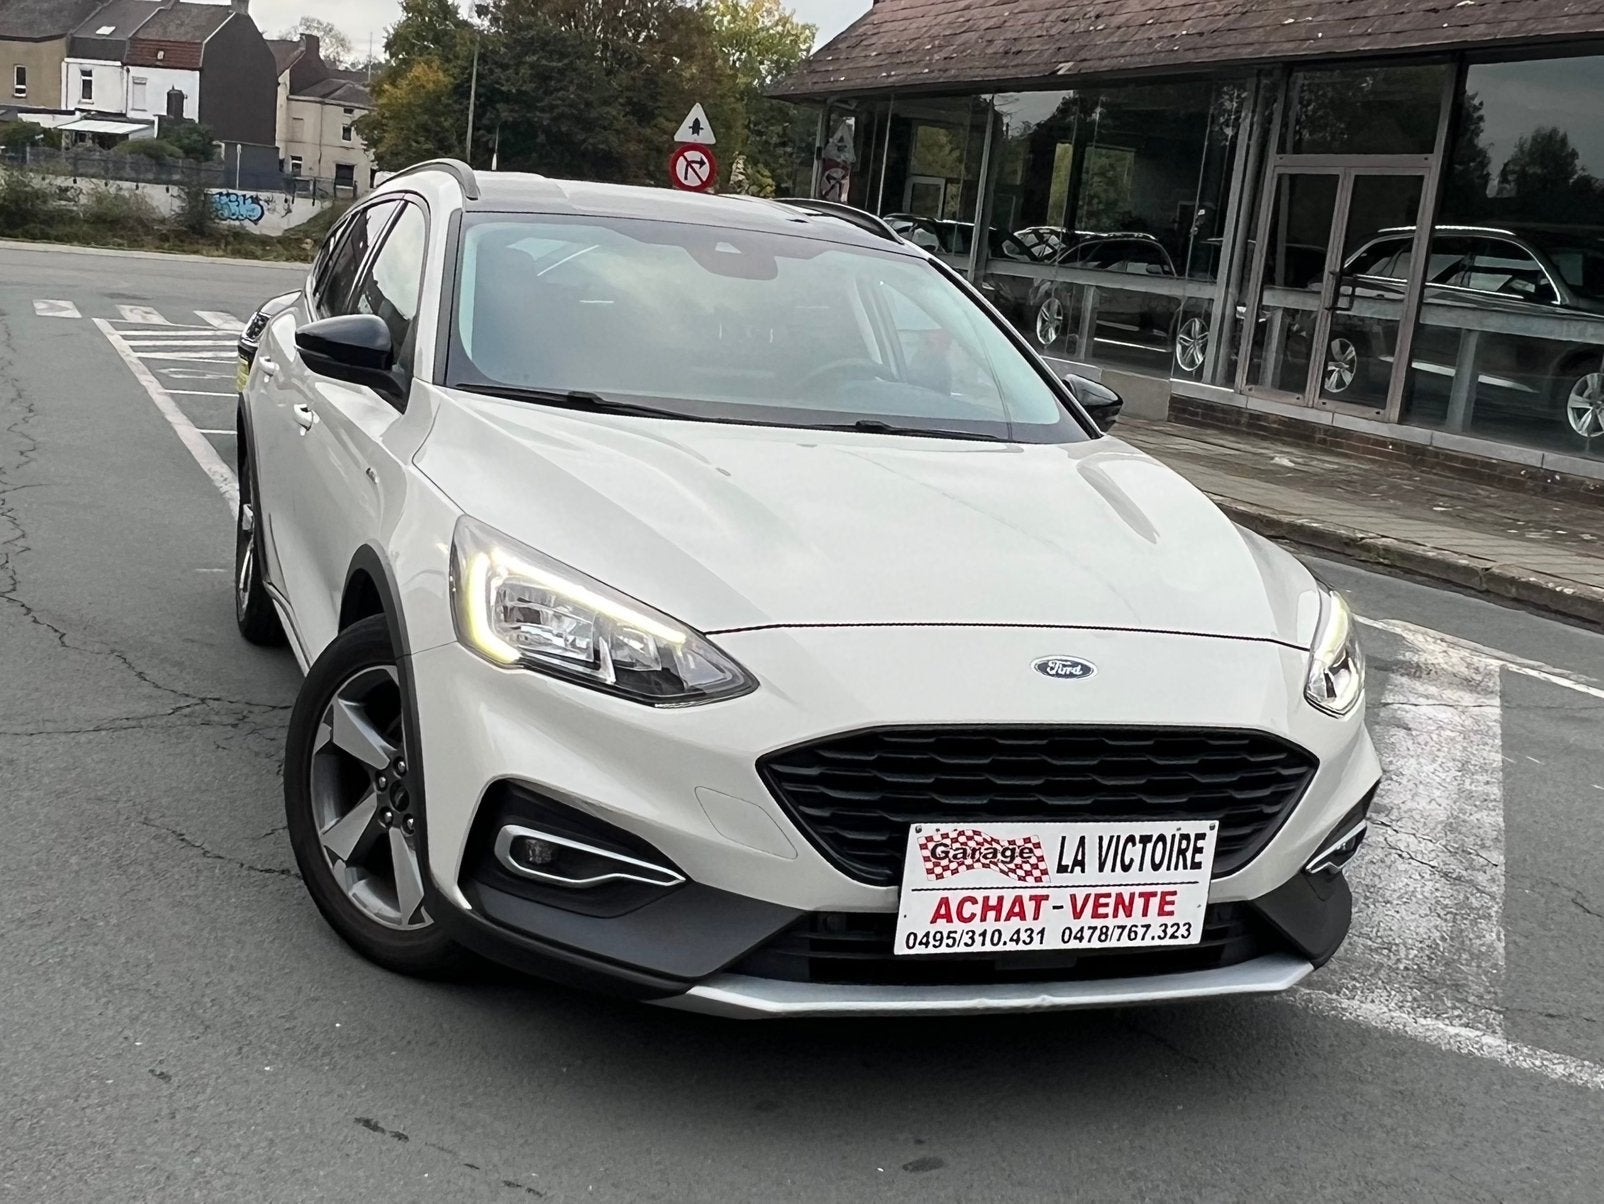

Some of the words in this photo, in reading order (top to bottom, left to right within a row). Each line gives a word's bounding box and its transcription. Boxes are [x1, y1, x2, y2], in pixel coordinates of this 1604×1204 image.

[1047, 660, 1083, 675] Ford
[930, 842, 1035, 865] Garage
[1056, 836, 1086, 873] LA
[1099, 833, 1206, 872] VICTOIRE
[905, 927, 1047, 950] 0495/310.431
[1060, 922, 1192, 944] 0478/767.323
